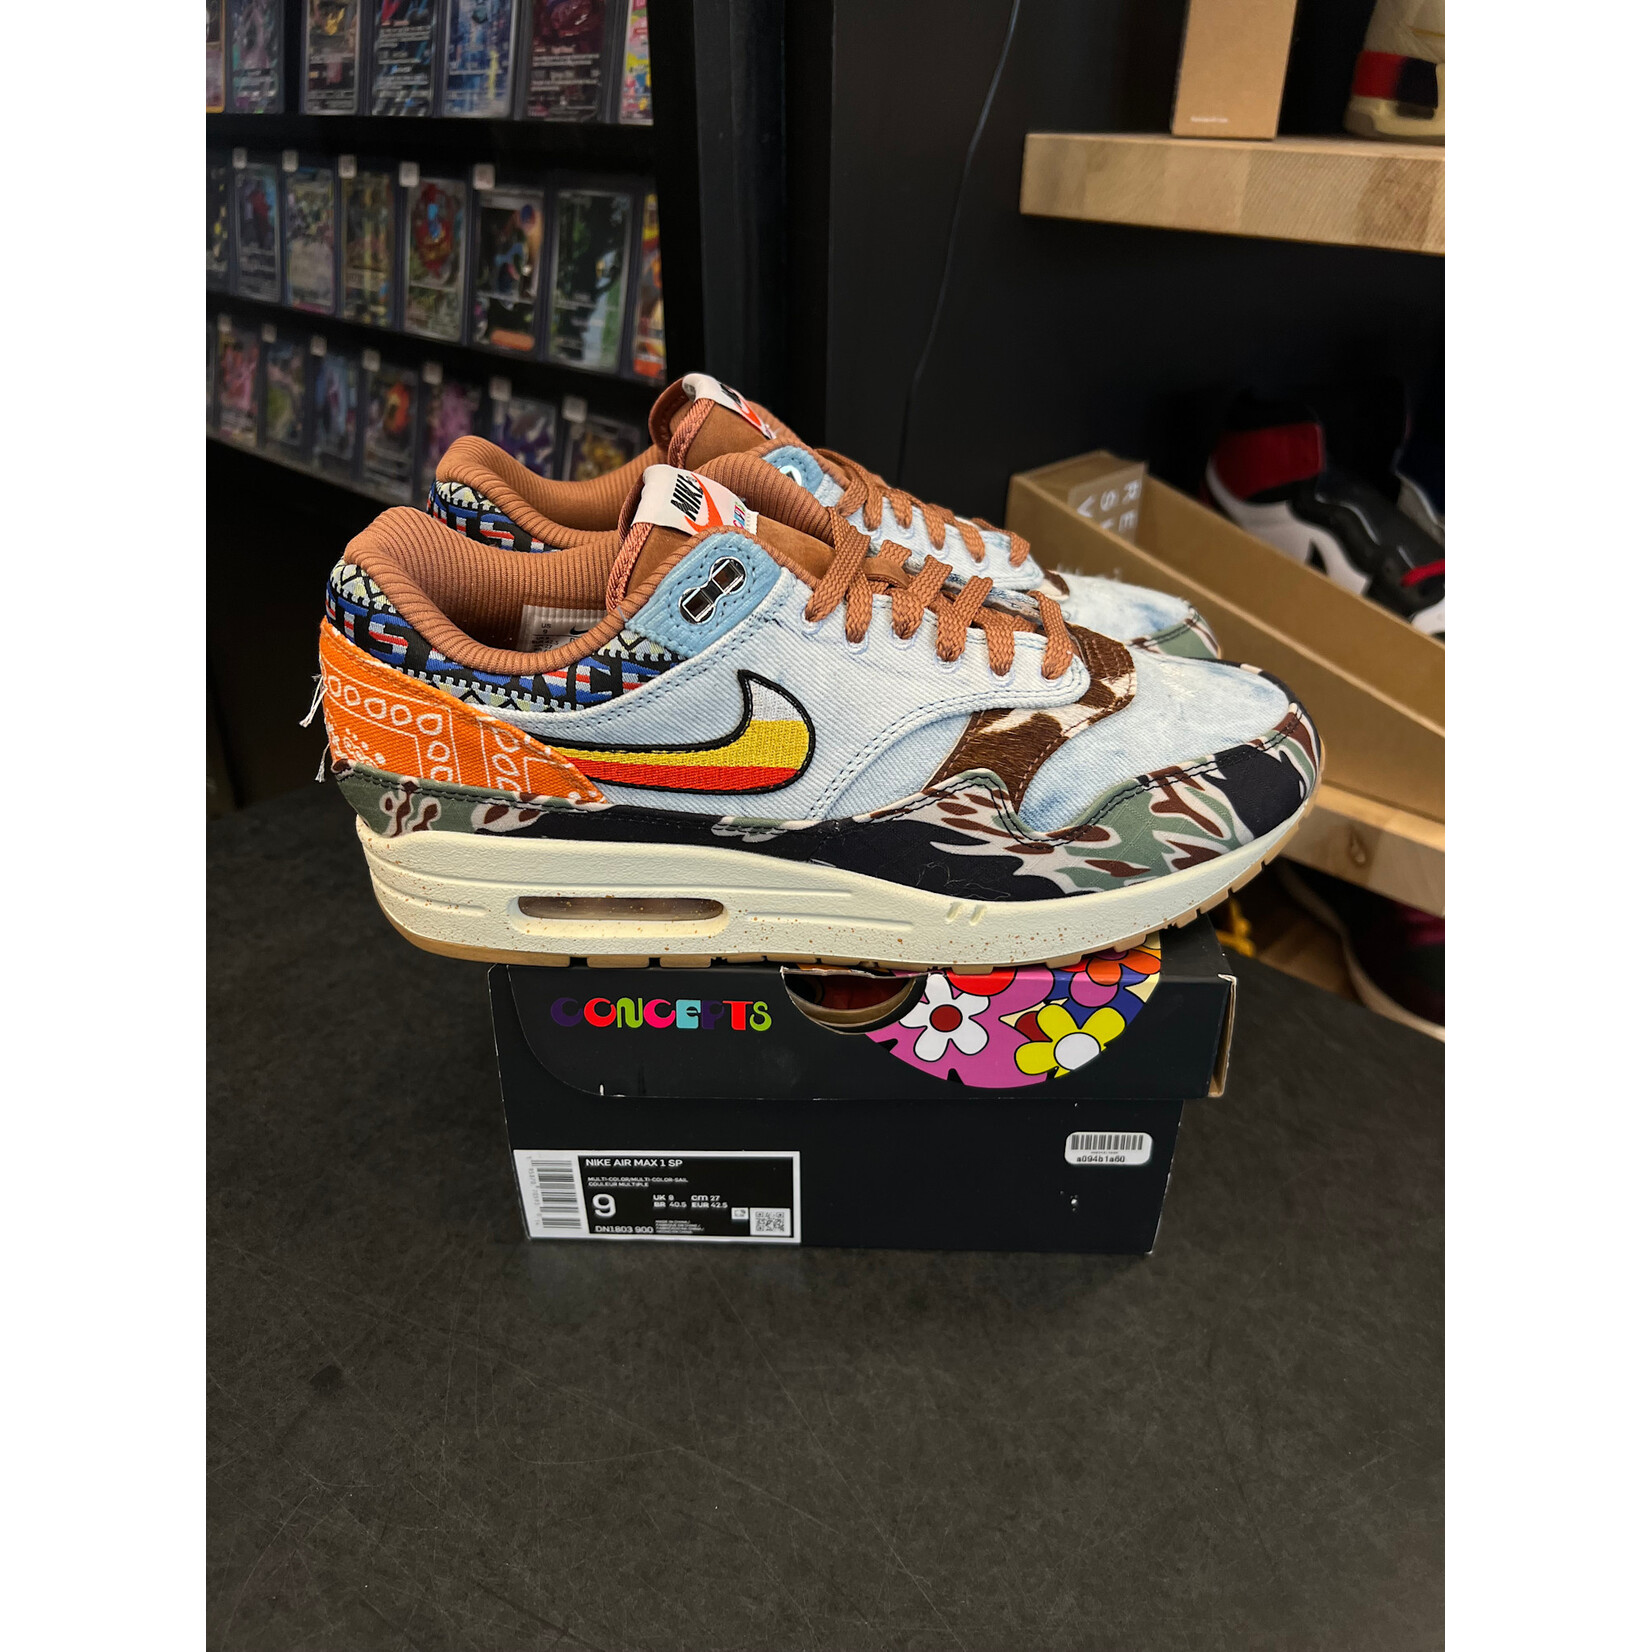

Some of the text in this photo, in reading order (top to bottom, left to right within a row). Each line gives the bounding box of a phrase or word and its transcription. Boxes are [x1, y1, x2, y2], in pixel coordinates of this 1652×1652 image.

[670, 474, 703, 522] NIKE
[551, 997, 772, 1032] CONCEPTS
[585, 1158, 683, 1167] NIKE AIR MAX 1 SP
[591, 1193, 617, 1218] 9
[595, 1225, 633, 1234] DN1803
[634, 1226, 654, 1234] 900
